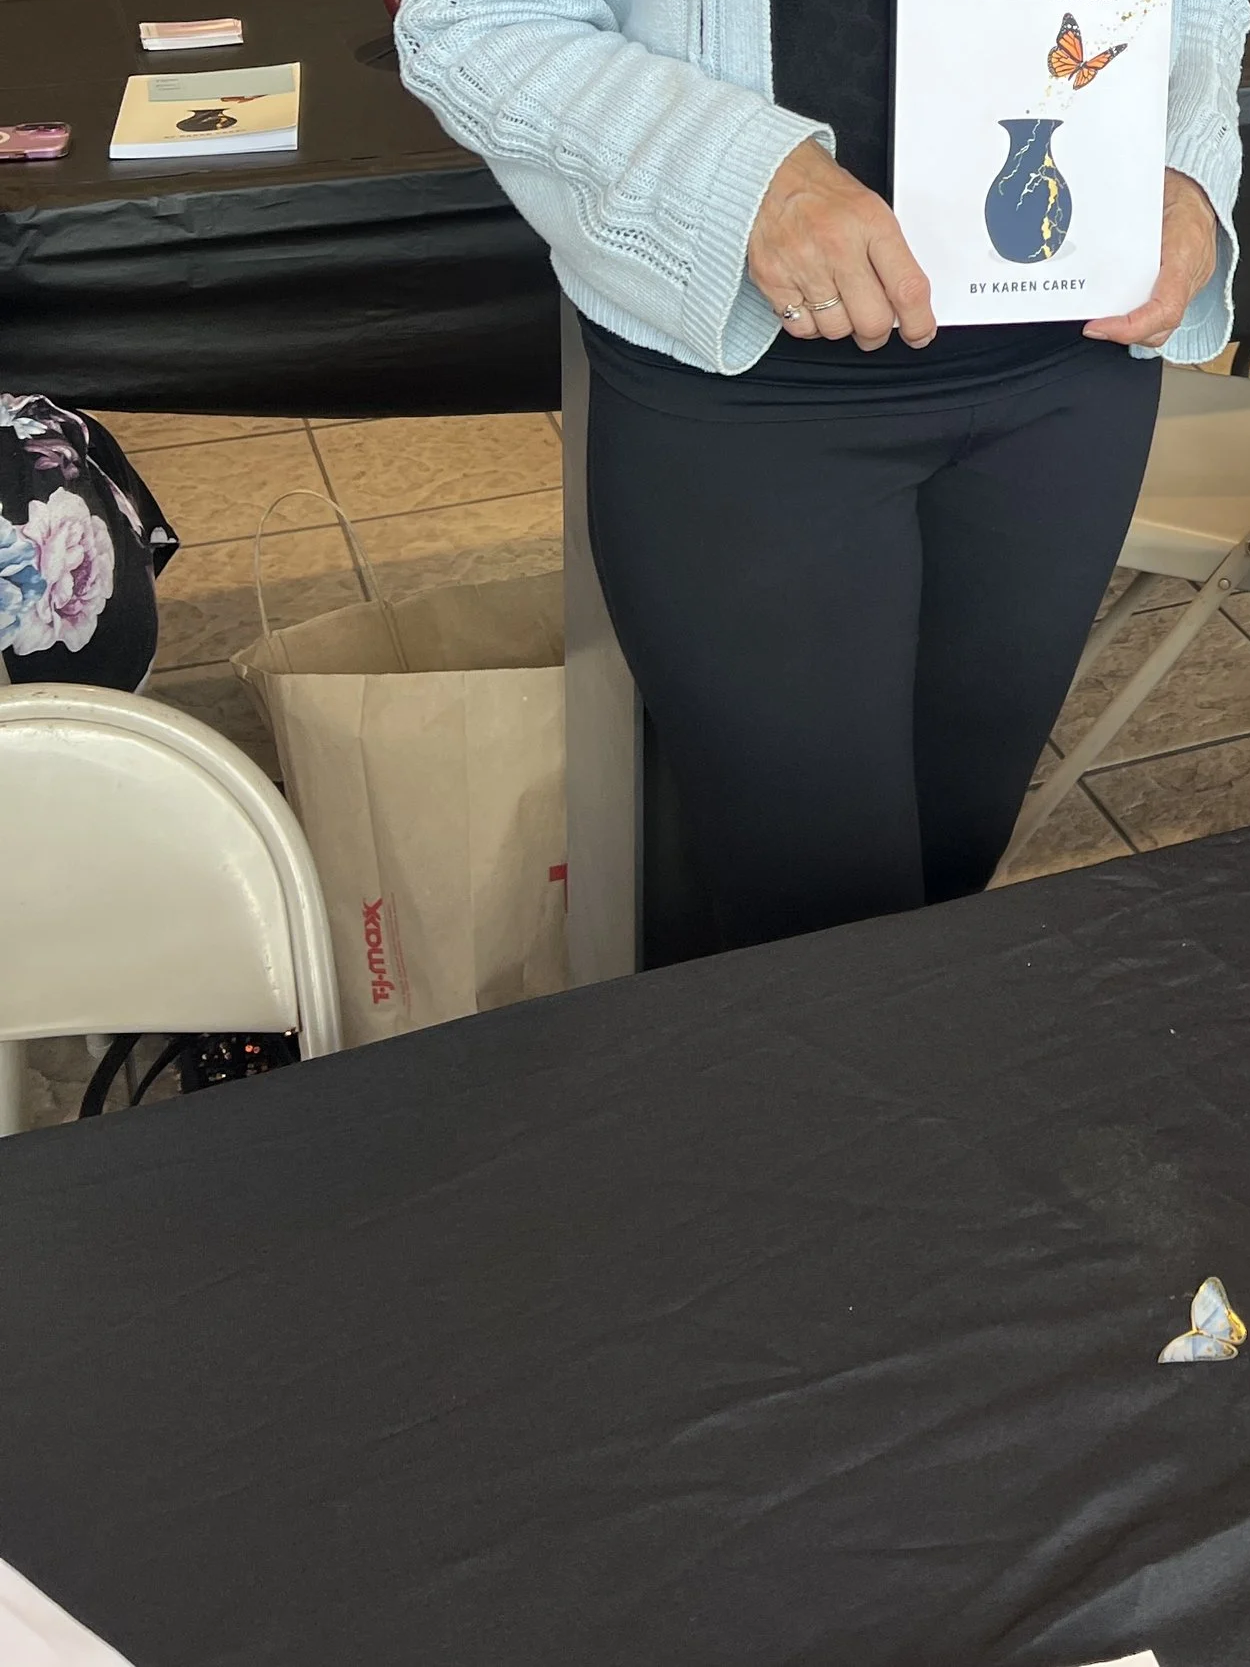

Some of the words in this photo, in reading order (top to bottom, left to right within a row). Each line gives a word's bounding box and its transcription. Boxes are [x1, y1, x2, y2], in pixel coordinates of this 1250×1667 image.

[970, 283, 987, 294] BY
[992, 281, 1037, 293] KAREN
[1043, 279, 1086, 291] CAREY
